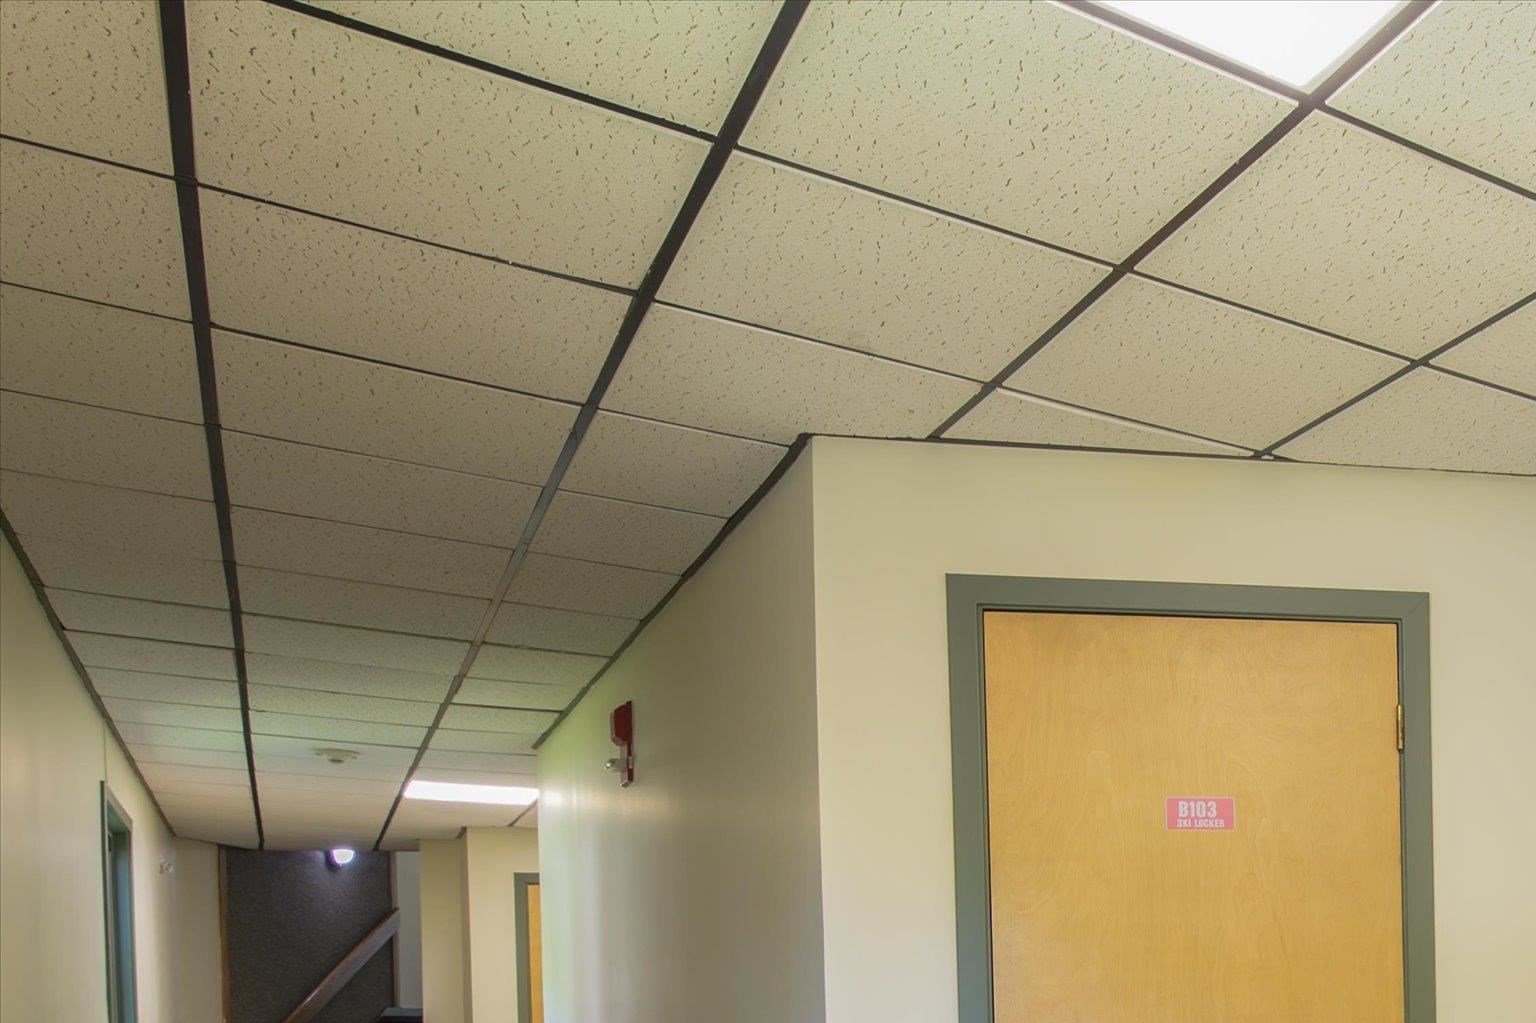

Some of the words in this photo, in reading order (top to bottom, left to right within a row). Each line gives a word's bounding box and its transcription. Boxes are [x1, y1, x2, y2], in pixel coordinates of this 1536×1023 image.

[1178, 800, 1217, 818] B103
[1177, 819, 1191, 828] SKI
[1194, 819, 1225, 828] LOCKER
